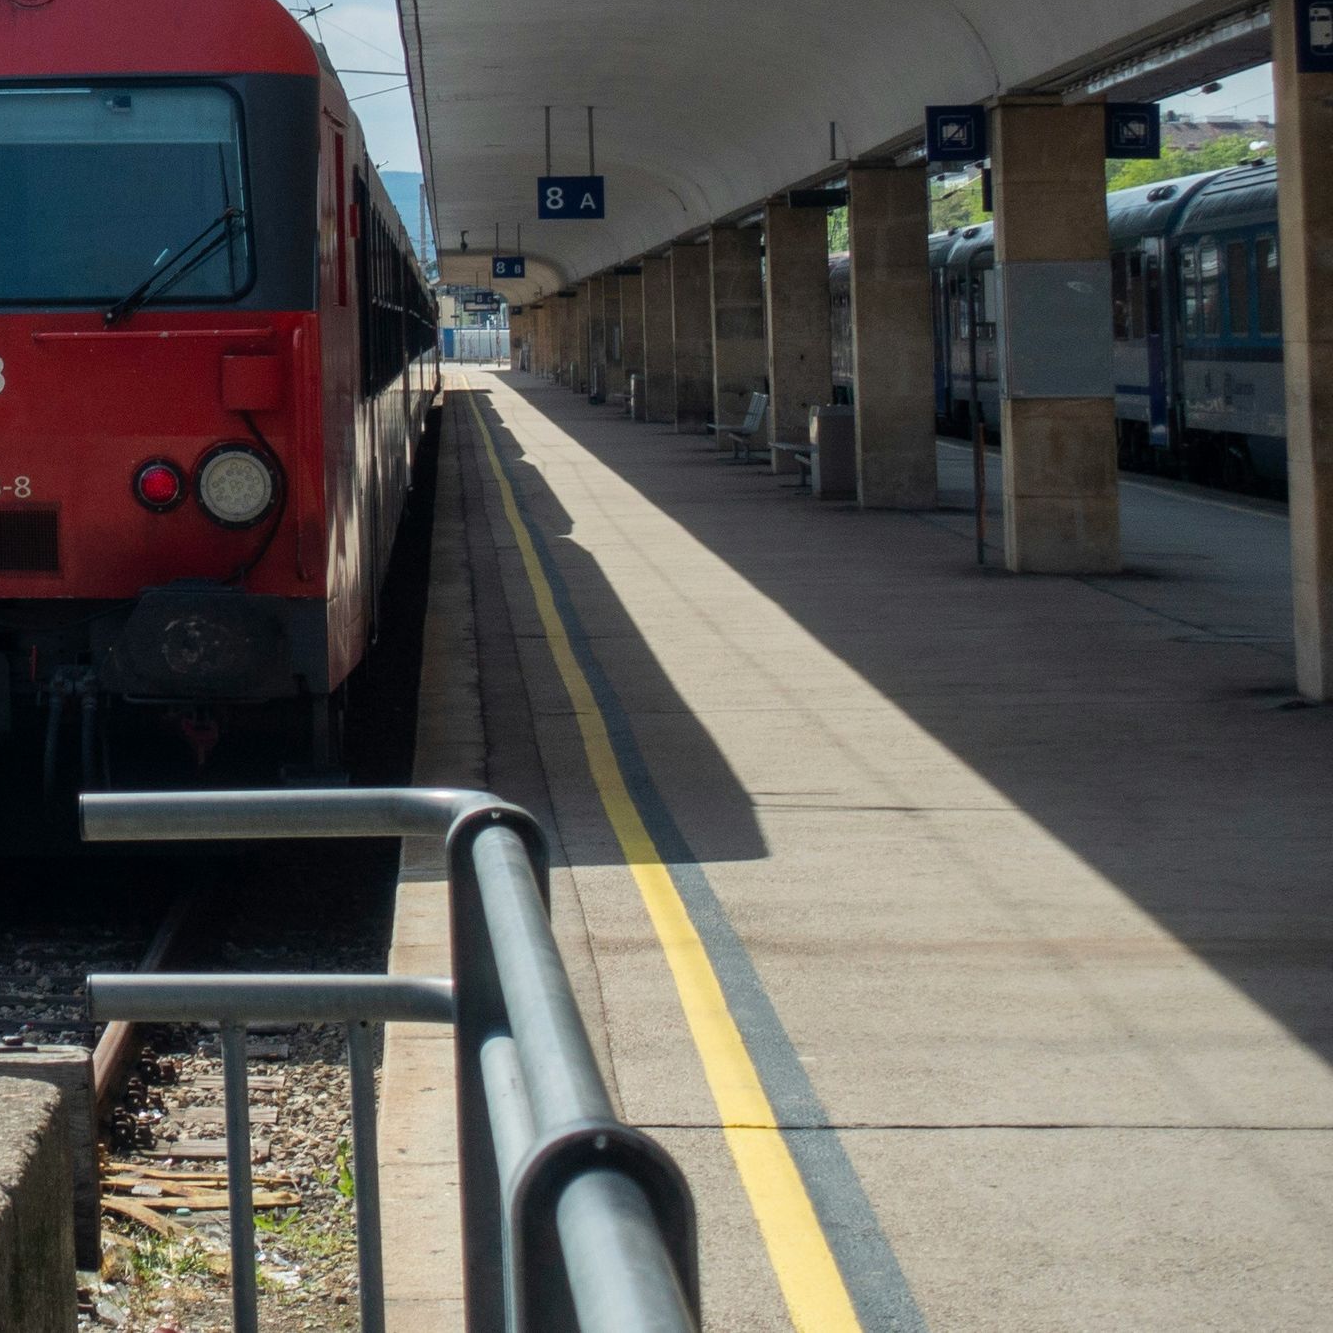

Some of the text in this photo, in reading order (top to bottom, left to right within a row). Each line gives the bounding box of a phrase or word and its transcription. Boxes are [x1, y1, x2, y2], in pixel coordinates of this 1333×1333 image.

[546, 187, 596, 209] 8 A
[496, 262, 521, 274] 8 B
